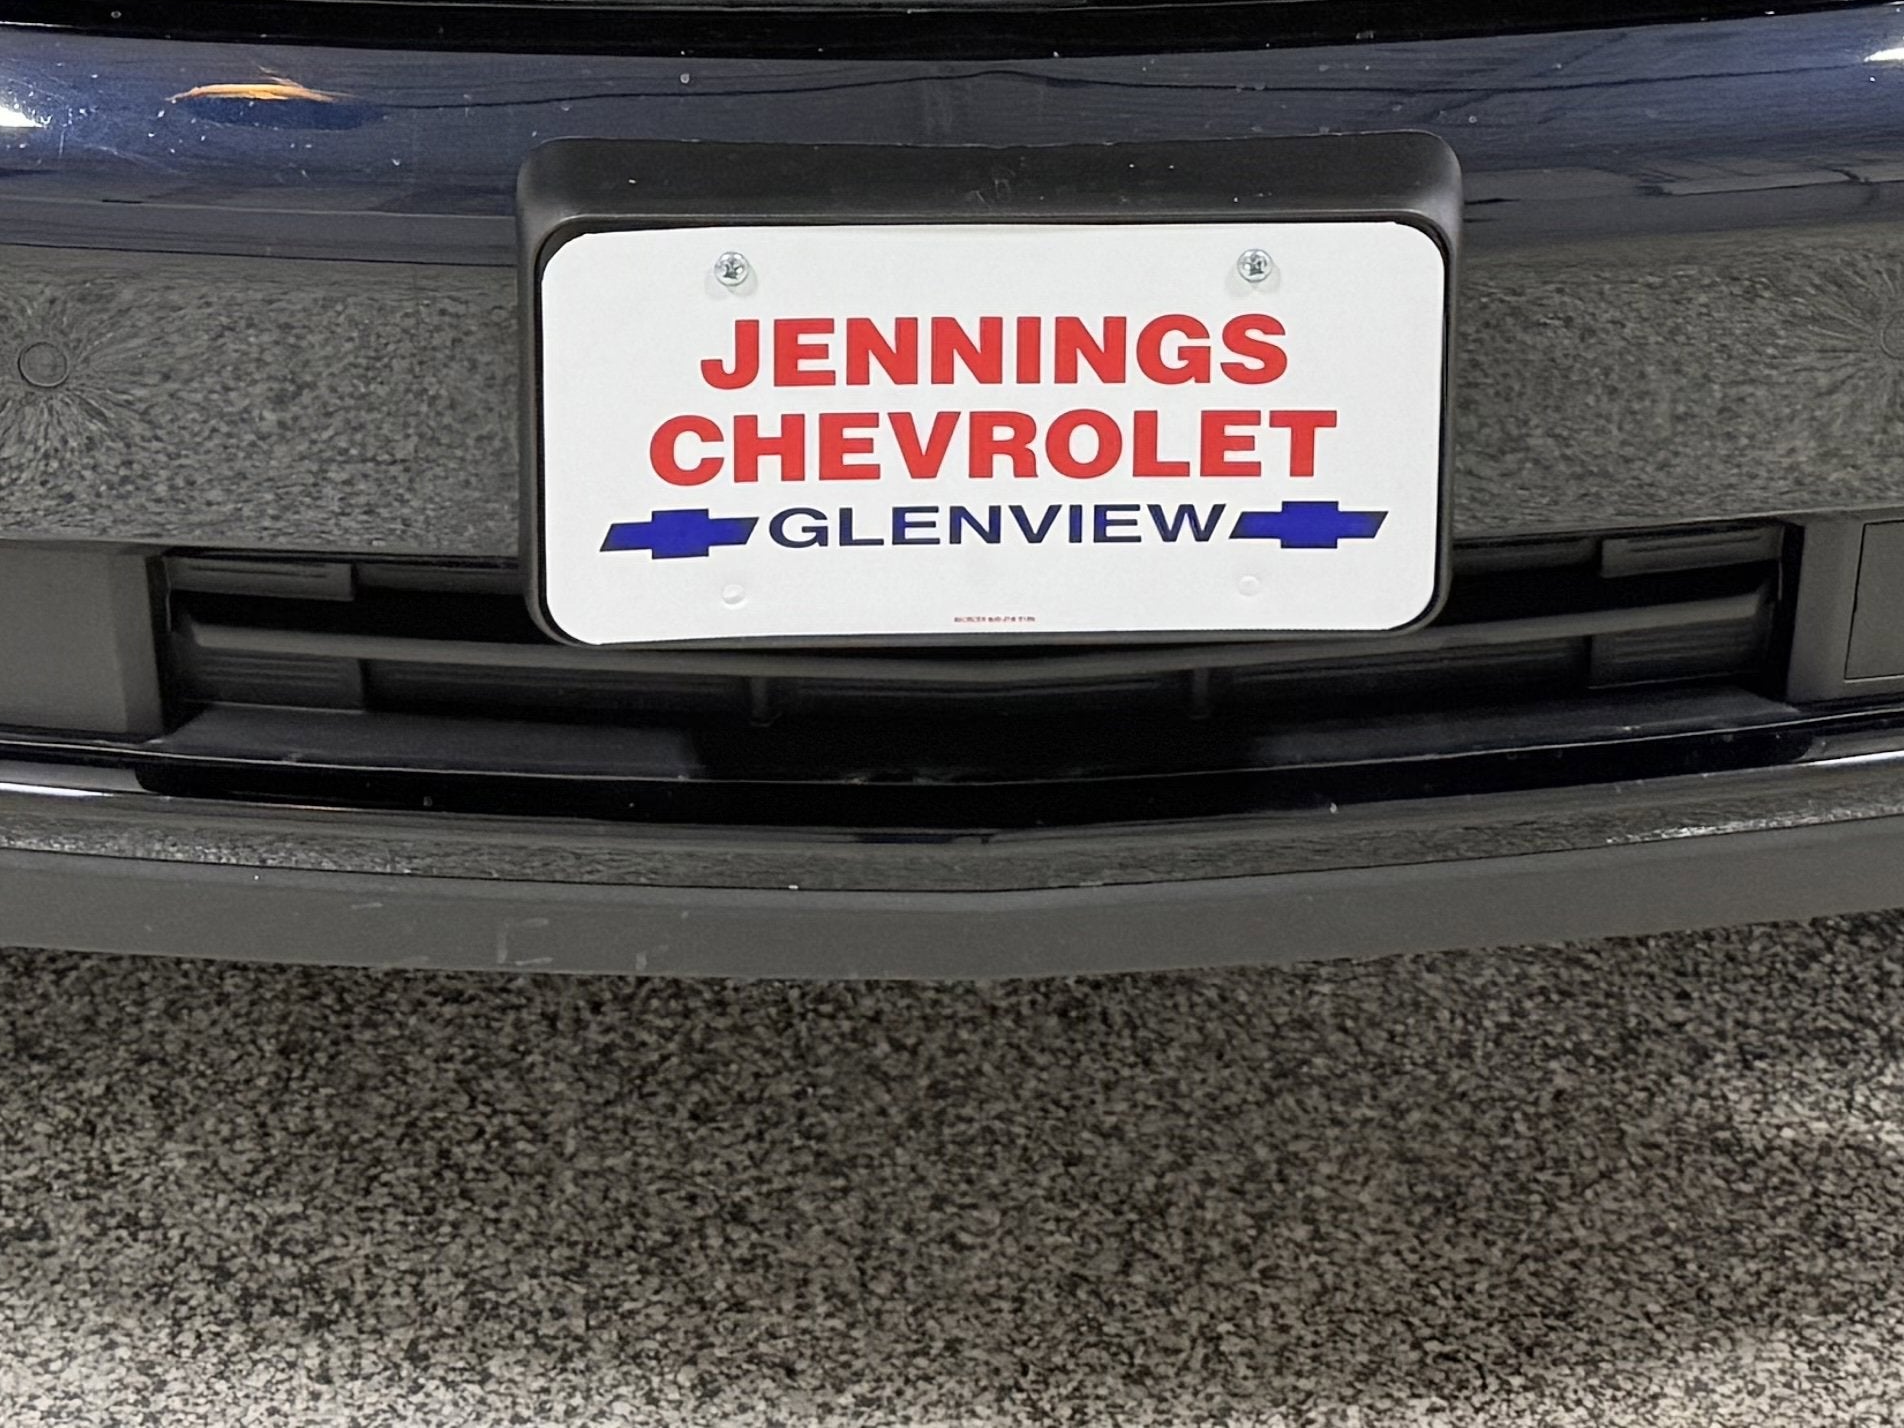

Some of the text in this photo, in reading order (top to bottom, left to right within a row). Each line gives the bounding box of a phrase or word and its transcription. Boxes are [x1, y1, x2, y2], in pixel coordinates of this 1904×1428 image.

[701, 314, 1288, 390] JENNINGS
[649, 408, 1337, 486] CHEVROLET
[768, 503, 1227, 548] GLENVIEW
